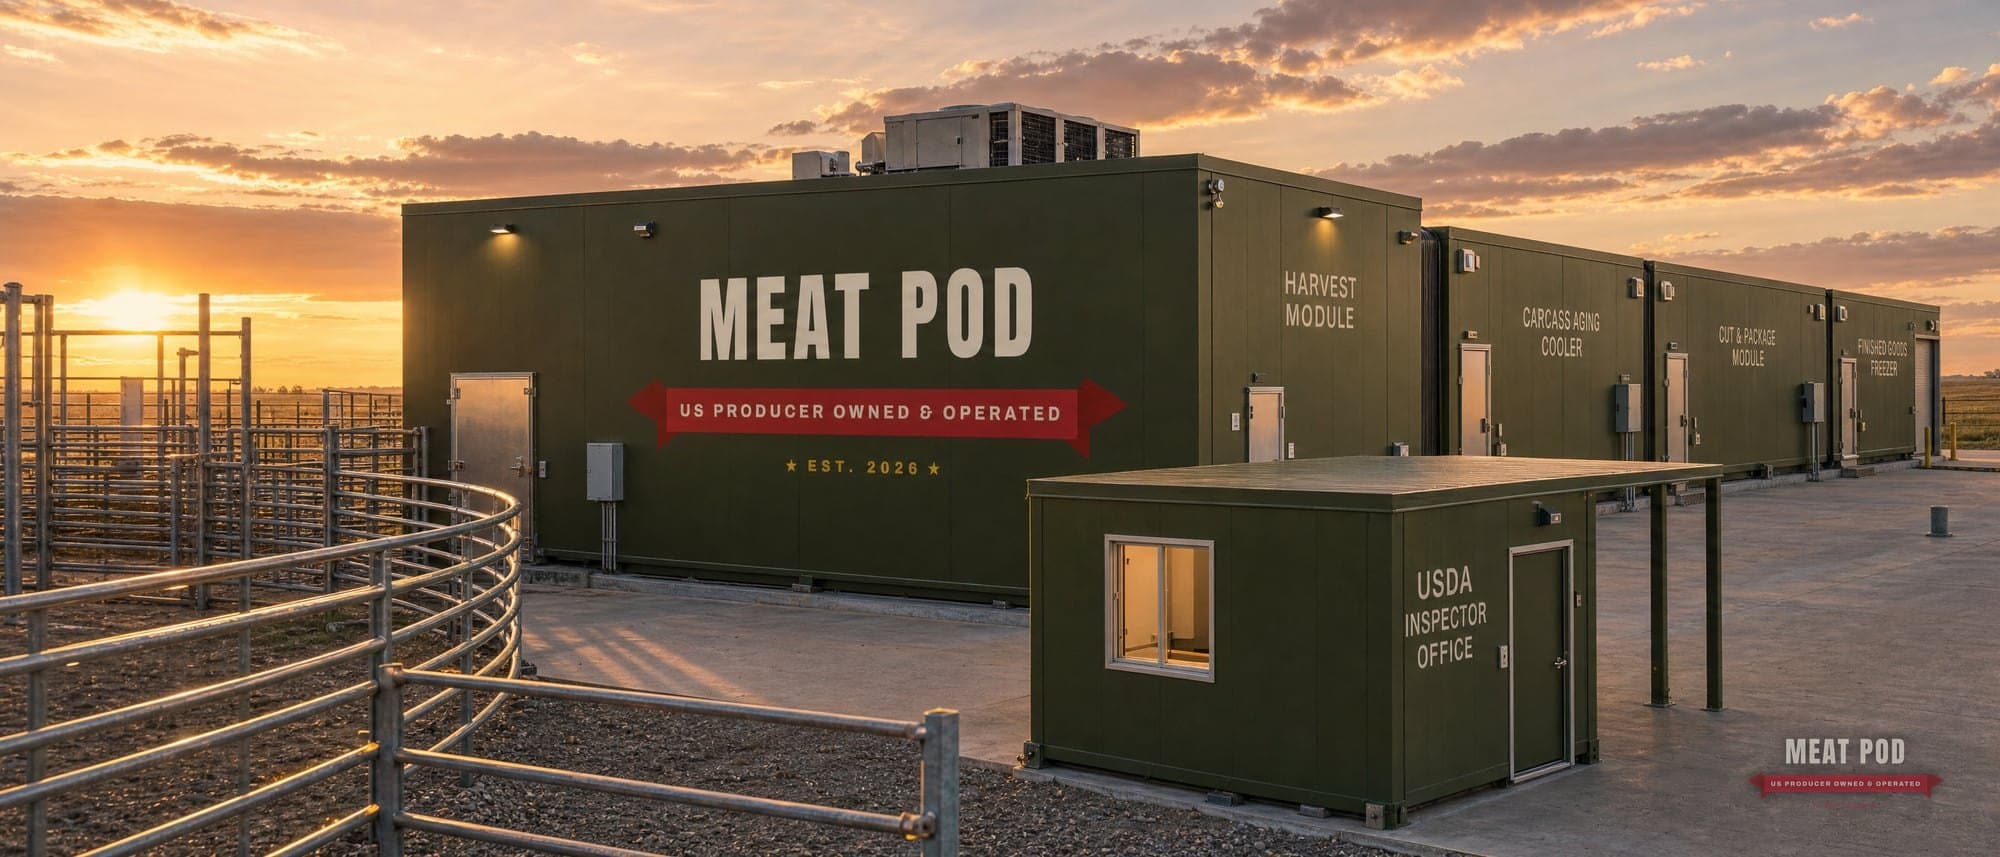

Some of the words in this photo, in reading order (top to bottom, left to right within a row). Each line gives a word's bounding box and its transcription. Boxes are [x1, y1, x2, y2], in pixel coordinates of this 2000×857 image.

[1285, 271, 1357, 299] HARVEST
[700, 273, 869, 361] MEAT
[902, 267, 1032, 358] POD
[1285, 303, 1354, 329] MODULE
[1522, 306, 1571, 331] CARCASS
[1573, 311, 1600, 333] AGING
[1541, 336, 1583, 357] COOLER
[1719, 325, 1735, 344] CUT
[1736, 327, 1742, 344] &
[1743, 328, 1776, 347] PACKAGE
[1857, 338, 1887, 356] FINISHED
[1887, 340, 1908, 357] GOODS
[1732, 349, 1765, 367] MODULE
[1870, 359, 1898, 377] FREEZER
[680, 403, 703, 418] US
[713, 403, 824, 419] PRODUCER
[833, 404, 910, 420] OWNED
[919, 405, 933, 420] &
[942, 404, 1060, 422] OPERATED
[807, 459, 853, 474] EST.
[866, 461, 918, 476] 2026
[1416, 565, 1473, 601] USDA
[1404, 602, 1488, 638] INSPECTOR
[1416, 635, 1474, 670] OFFICE
